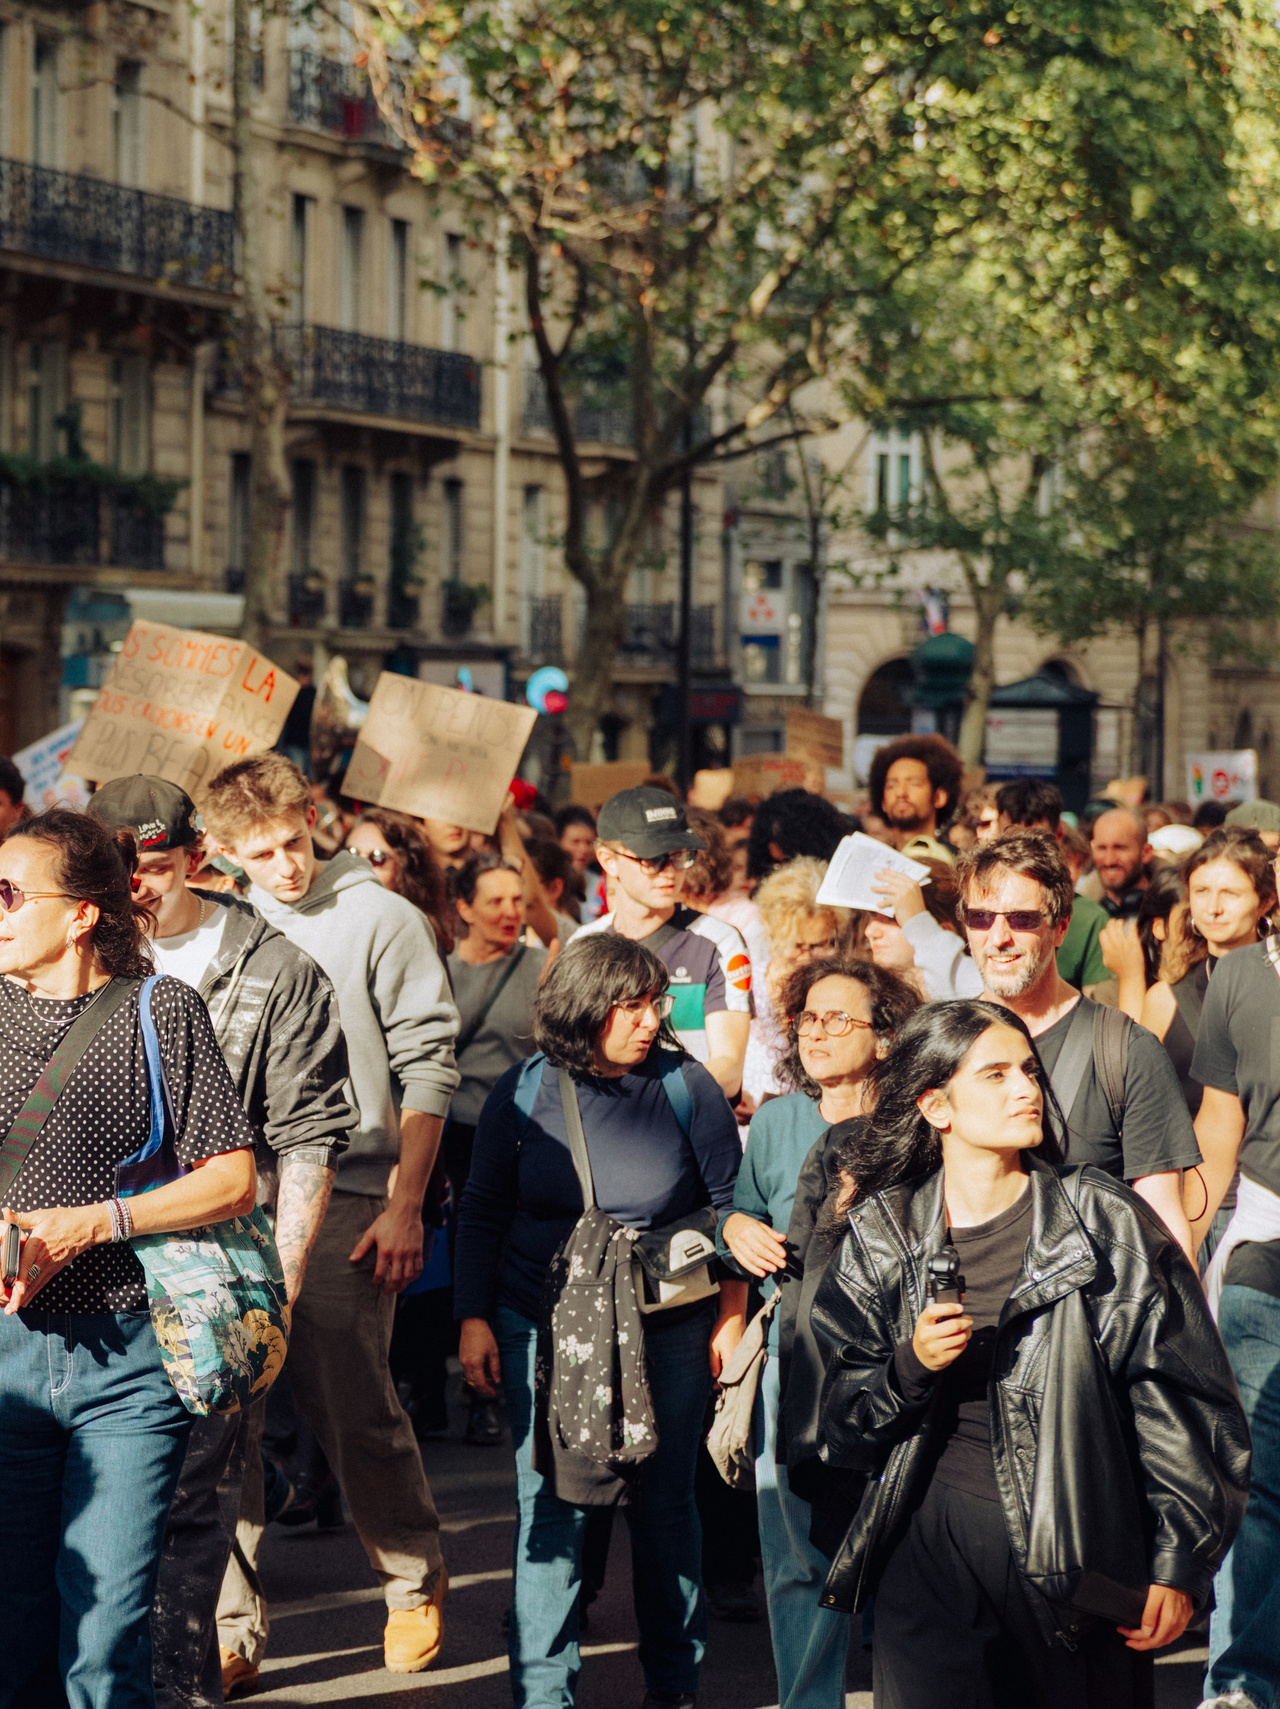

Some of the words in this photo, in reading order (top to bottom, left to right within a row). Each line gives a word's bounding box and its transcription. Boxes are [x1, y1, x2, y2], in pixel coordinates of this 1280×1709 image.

[146, 634, 241, 678] SOMMES
[241, 656, 278, 703] LA
[222, 730, 253, 756] UN
